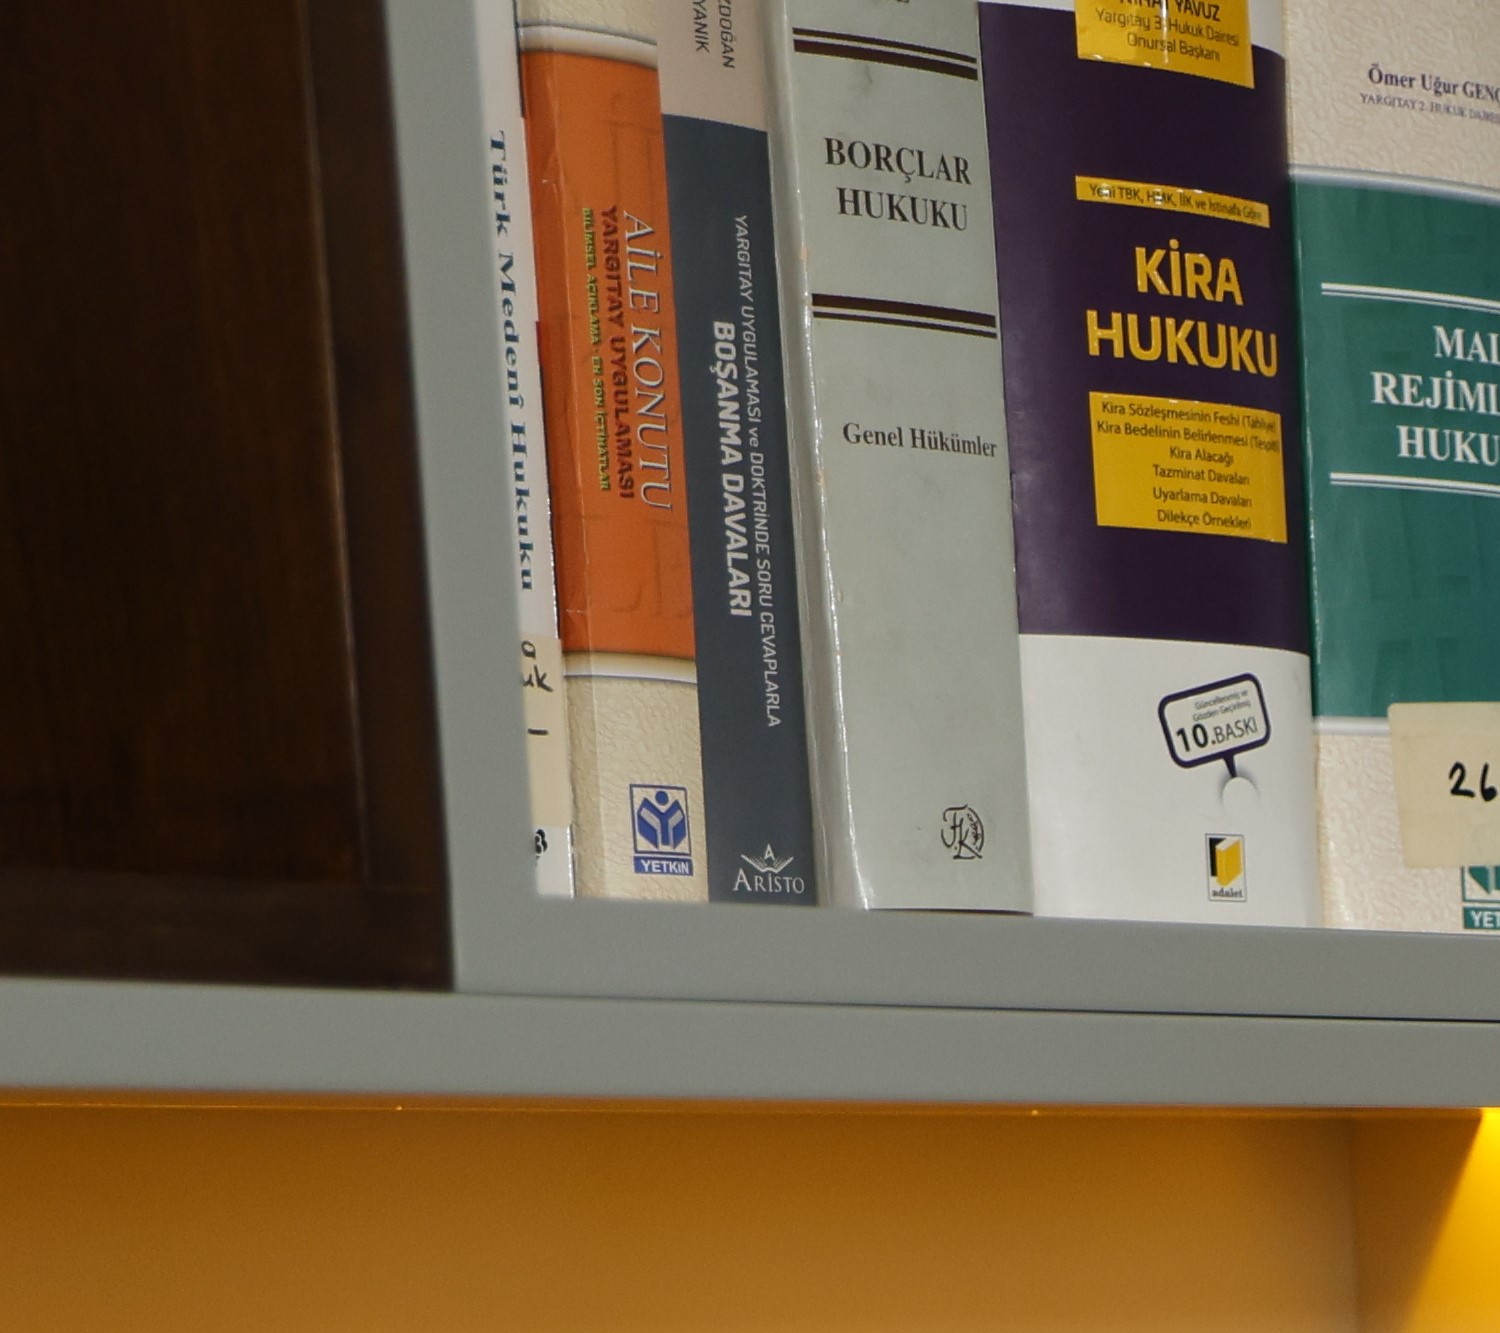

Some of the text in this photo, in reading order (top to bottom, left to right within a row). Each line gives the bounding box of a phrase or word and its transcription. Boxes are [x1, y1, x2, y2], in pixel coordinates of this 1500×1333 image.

[1367, 64, 1415, 89] Ömer
[1421, 73, 1459, 97] Uğur
[824, 137, 972, 185] BORÇLAR
[836, 187, 968, 232] HUKUKU
[1134, 239, 1244, 306] KİRA
[489, 130, 535, 591] Türk Hukuku
[601, 205, 635, 499] YARGITAY UYGULAMASI
[624, 210, 673, 510] AİLE KONUTU
[1086, 309, 1279, 378] HUKUKU
[1097, 420, 1121, 436] Kira
[1102, 401, 1125, 416] Kira
[842, 421, 998, 459] Genel Hükümler
[1169, 447, 1193, 462] Kira
[710, 320, 753, 618] BOŞANMA DAVALARI
[734, 214, 782, 728] YARGITAY UYGULAMASI ve DOKTRİNDE SORU CEVAPLARLA
[1152, 464, 1206, 482] Tazminat
[1449, 762, 1497, 801] 26
